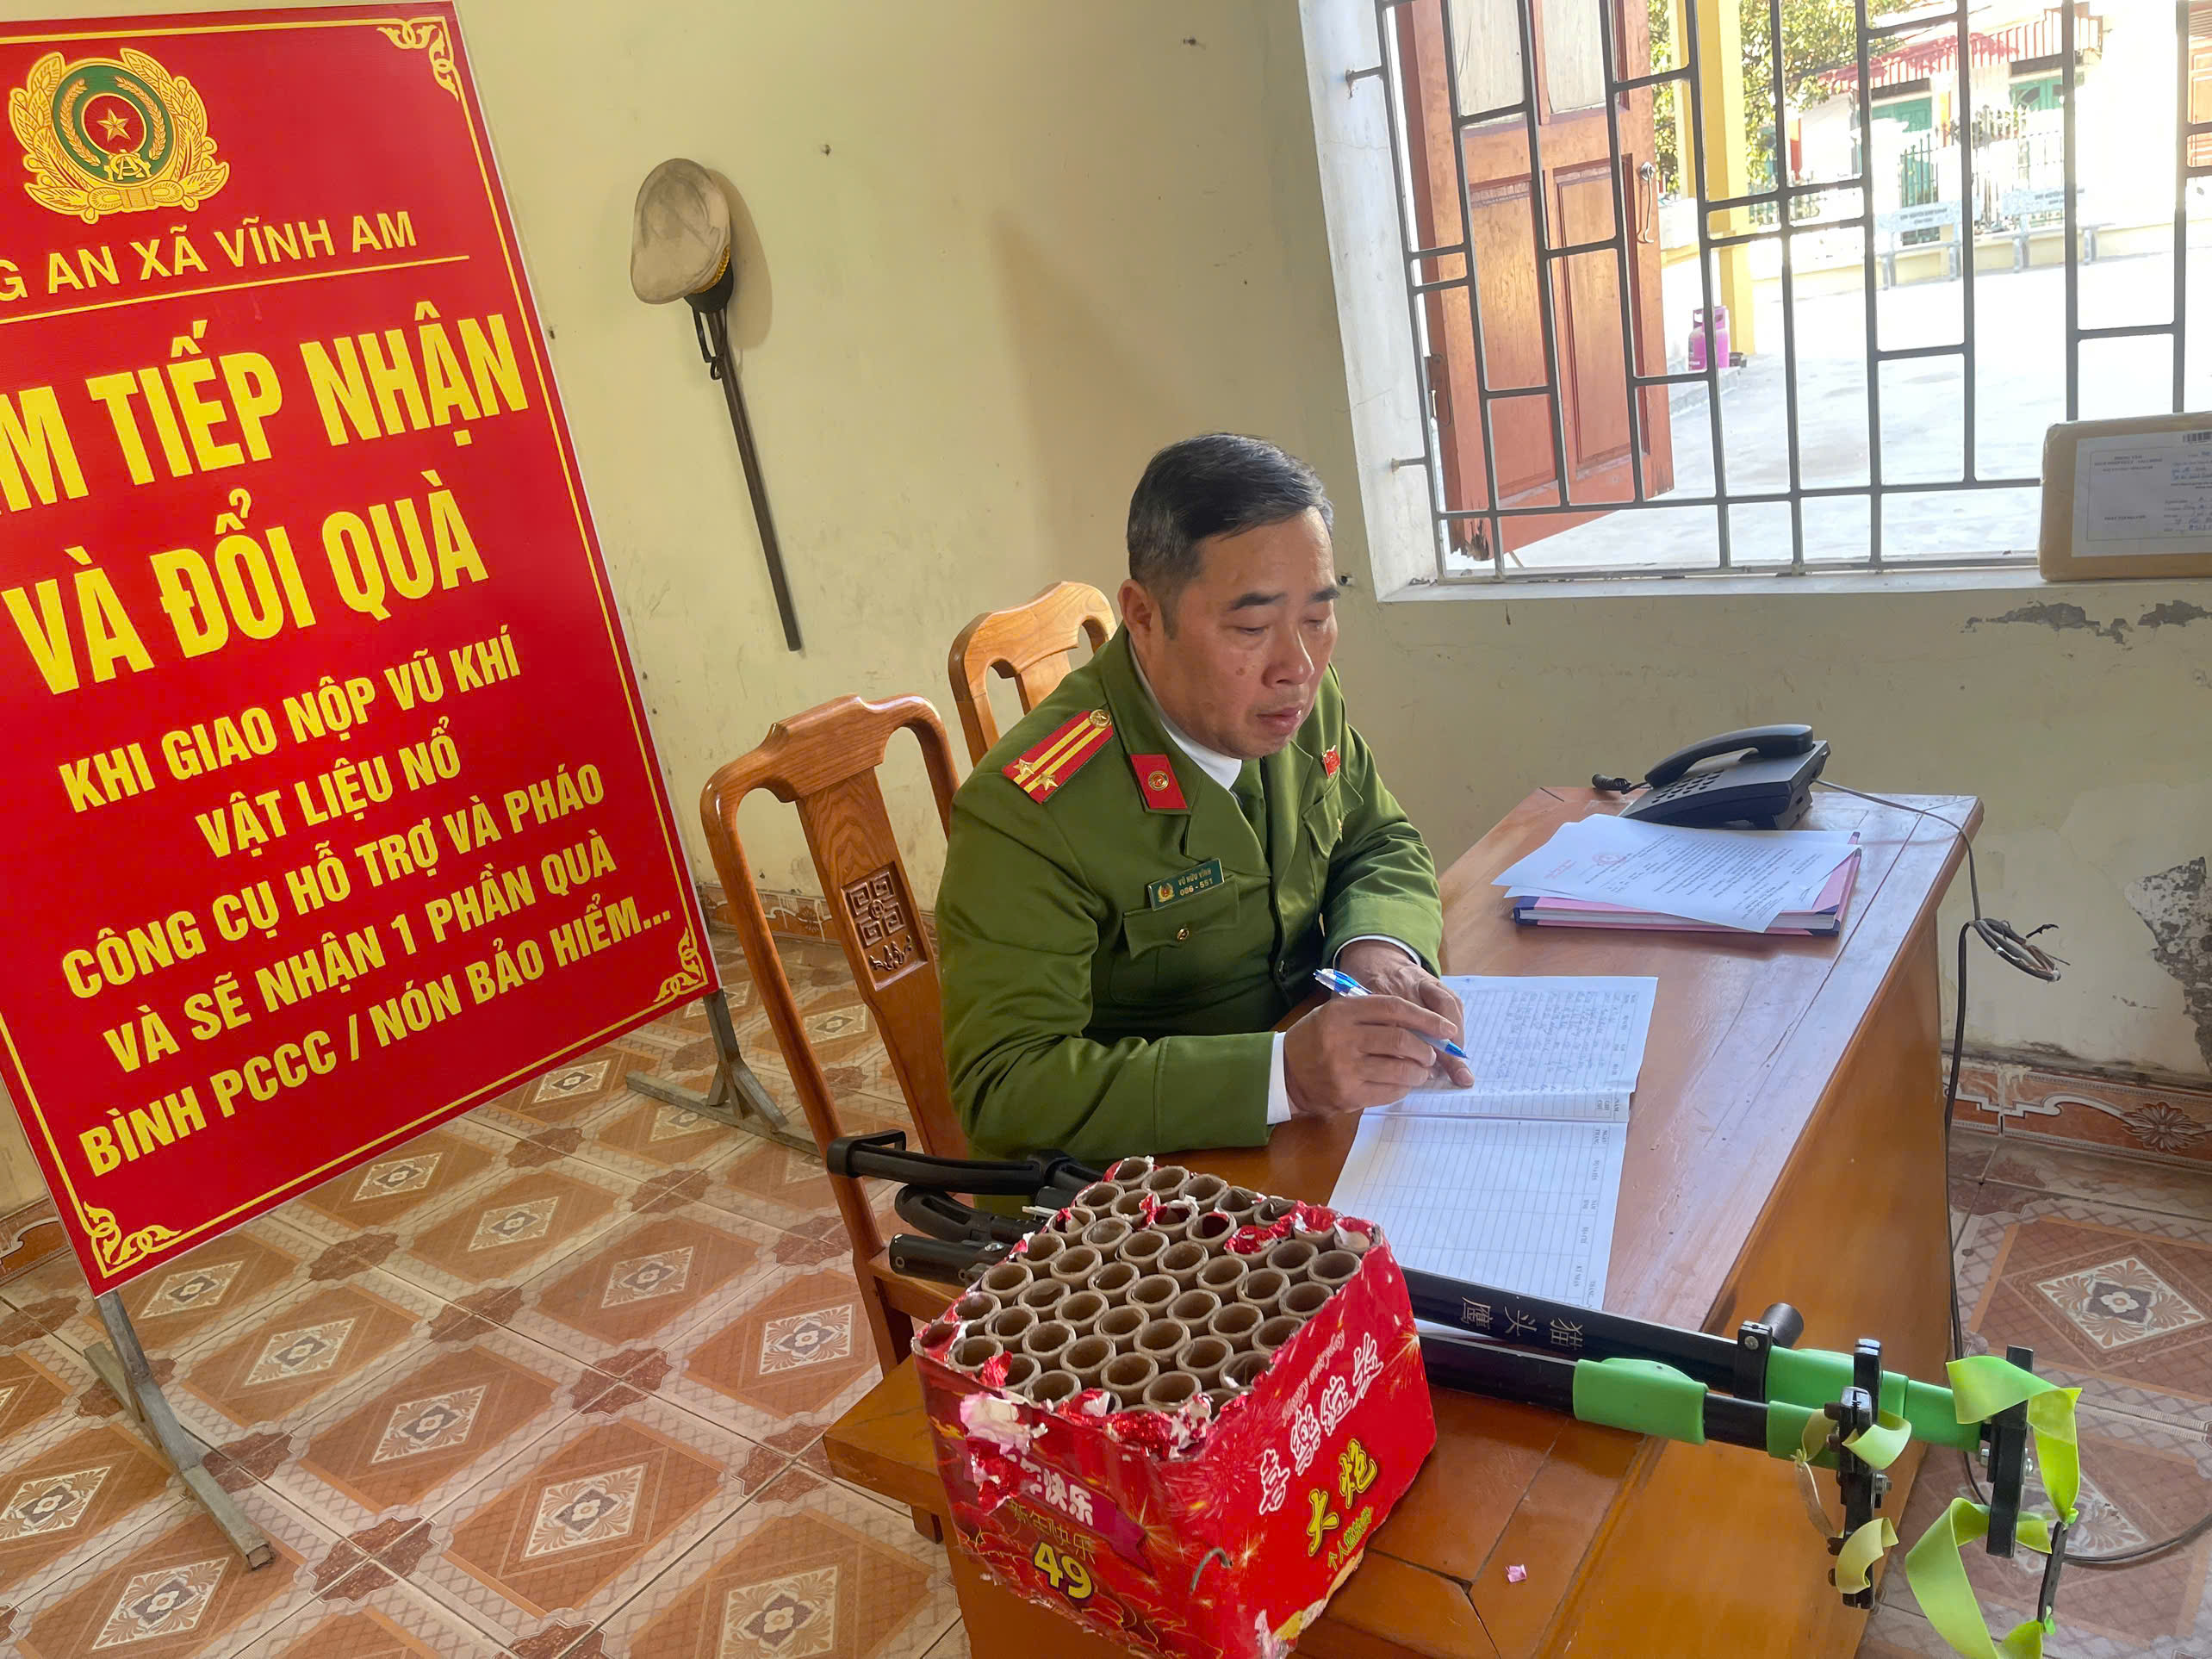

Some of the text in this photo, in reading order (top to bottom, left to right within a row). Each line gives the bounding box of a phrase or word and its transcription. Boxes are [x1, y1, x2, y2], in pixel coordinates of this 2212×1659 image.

[47, 245, 121, 294] AN
[130, 224, 208, 280] XÃ
[213, 216, 335, 268] VĨNH
[352, 210, 417, 253] AM
[84, 319, 283, 486] TIẾP
[299, 300, 529, 447] NHẬN
[0, 469, 488, 695] VÀ ĐỔI QUÀ
[59, 624, 520, 813] KHI GIAO NỘP VŨ KHÍ
[195, 716, 461, 858] VẬT LIỆU NỔ
[62, 764, 604, 998] CÔNG CỤ HỖ TRỢ VÀ PHÁO
[103, 829, 617, 1072] VÀ SẼ NHẬN 1 PHẦN QUÀ
[78, 1086, 207, 1177] BÌNH
[209, 1030, 337, 1117] PCCC
[348, 1014, 359, 1061] /
[369, 974, 463, 1047] NÓN
[465, 937, 544, 1004] BẢO
[1035, 1542, 1092, 1600] 49
